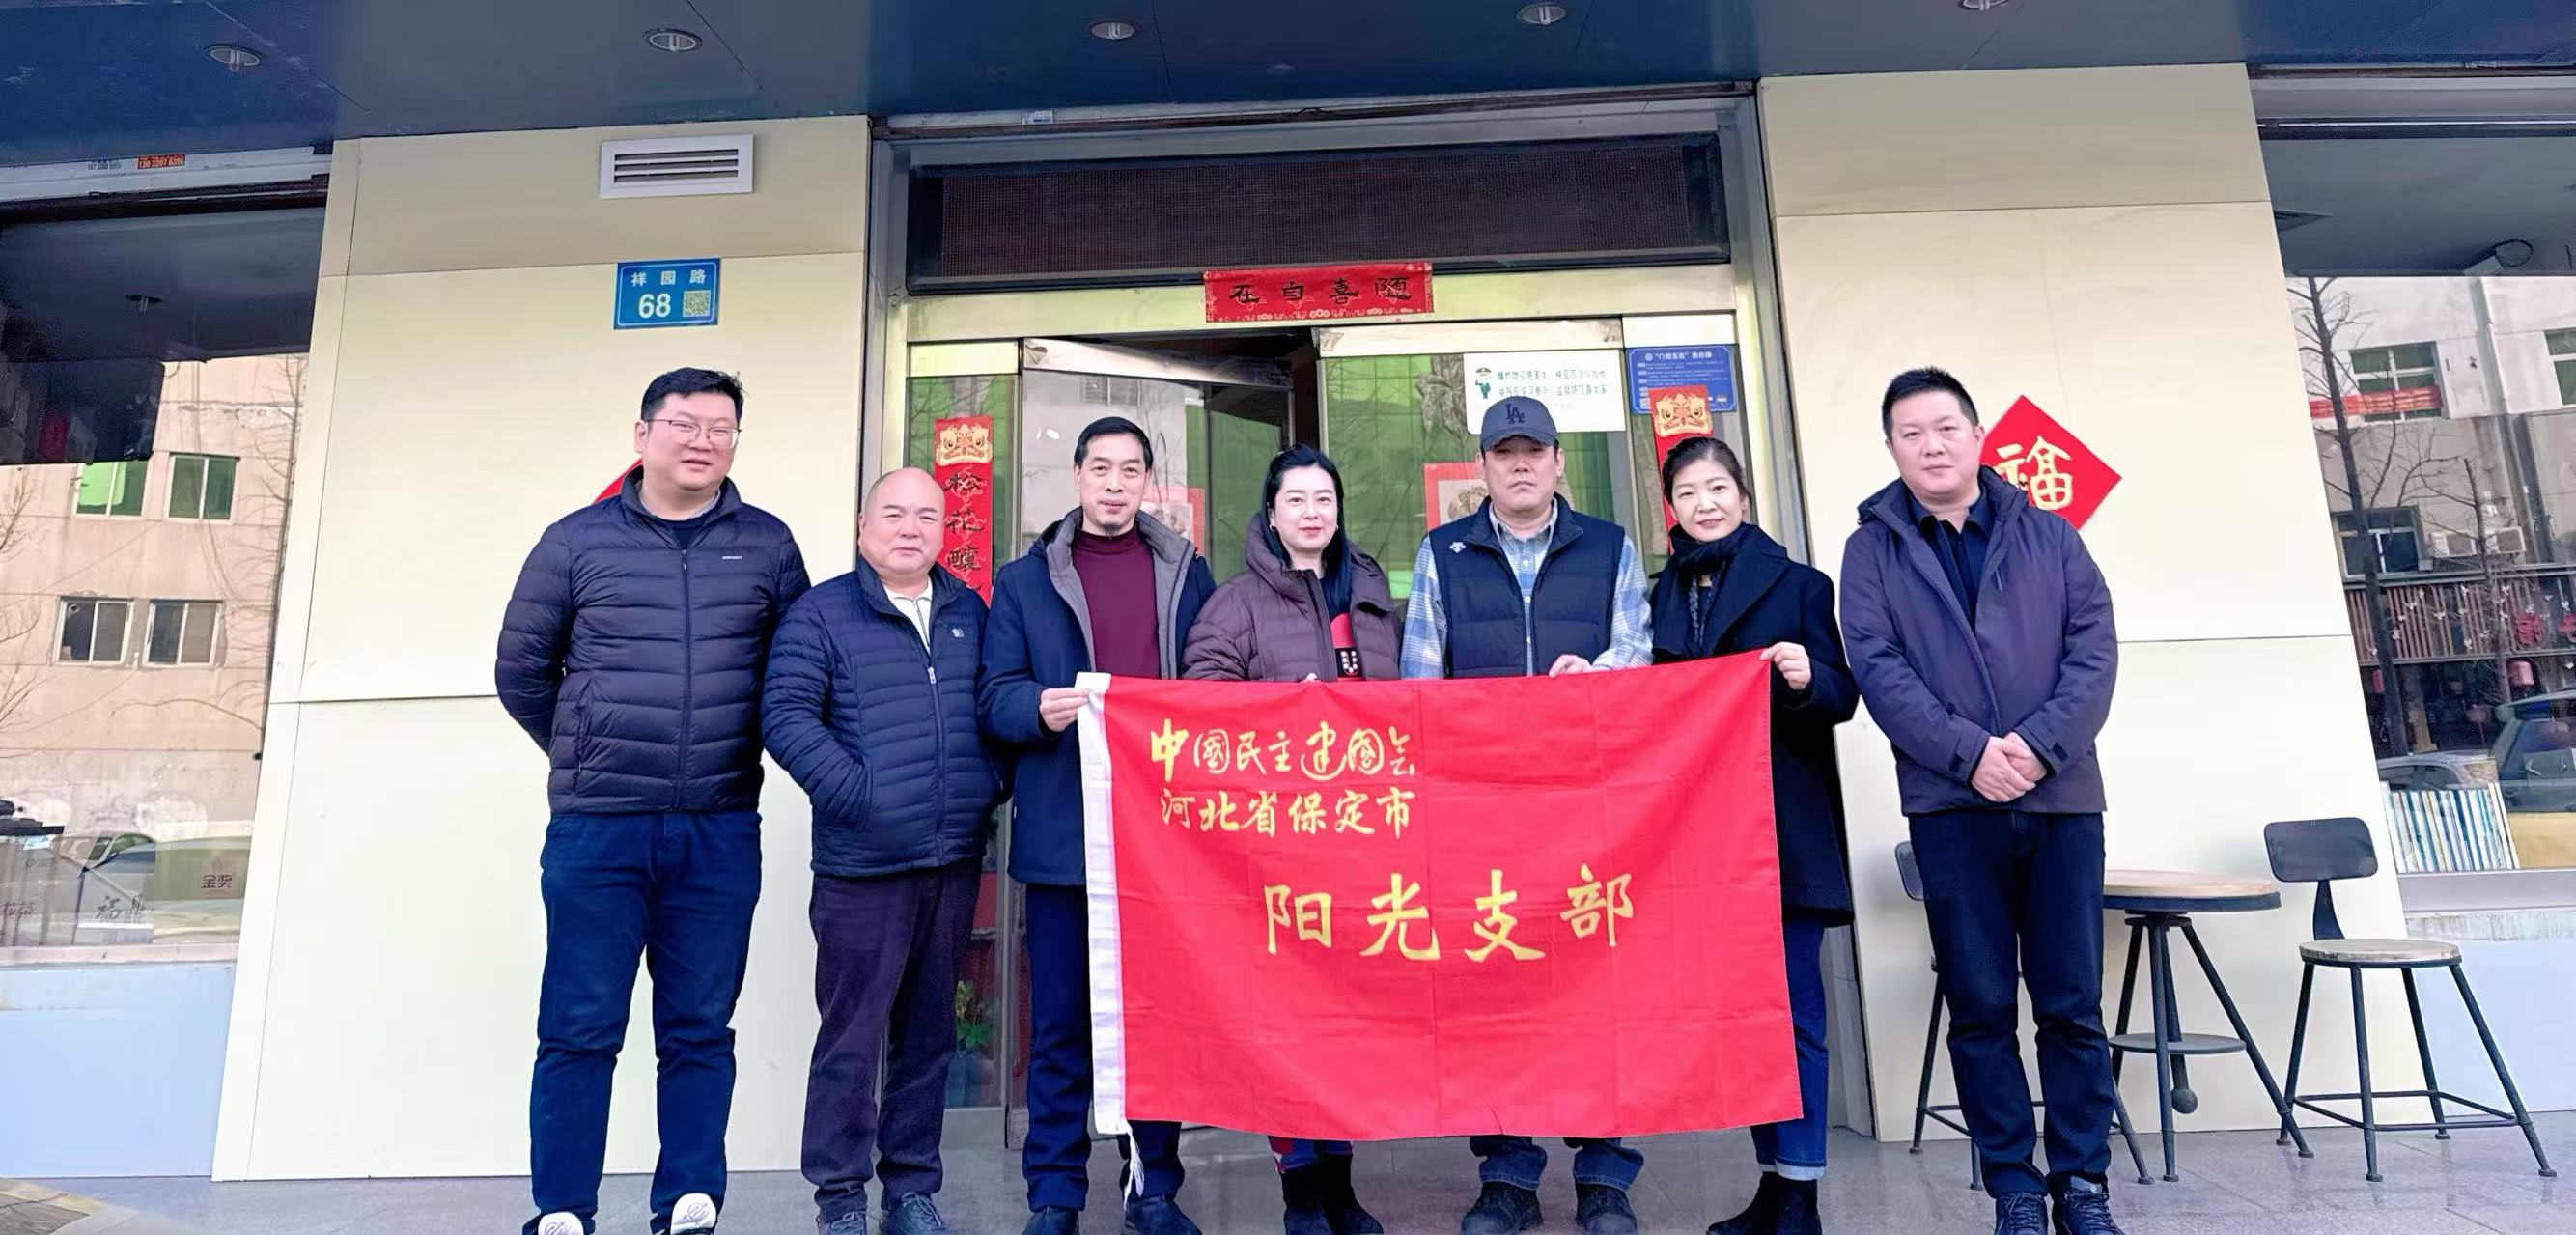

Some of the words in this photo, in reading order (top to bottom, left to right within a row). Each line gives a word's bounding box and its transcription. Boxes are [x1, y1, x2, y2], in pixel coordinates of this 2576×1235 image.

[631, 269, 706, 287] 祥园路
[638, 293, 671, 319] 68
[1505, 404, 1525, 424] LA
[1995, 435, 2071, 510] 福
[1160, 787, 1415, 839] 河北省保定市
[1263, 863, 1635, 964] 阳光支部
